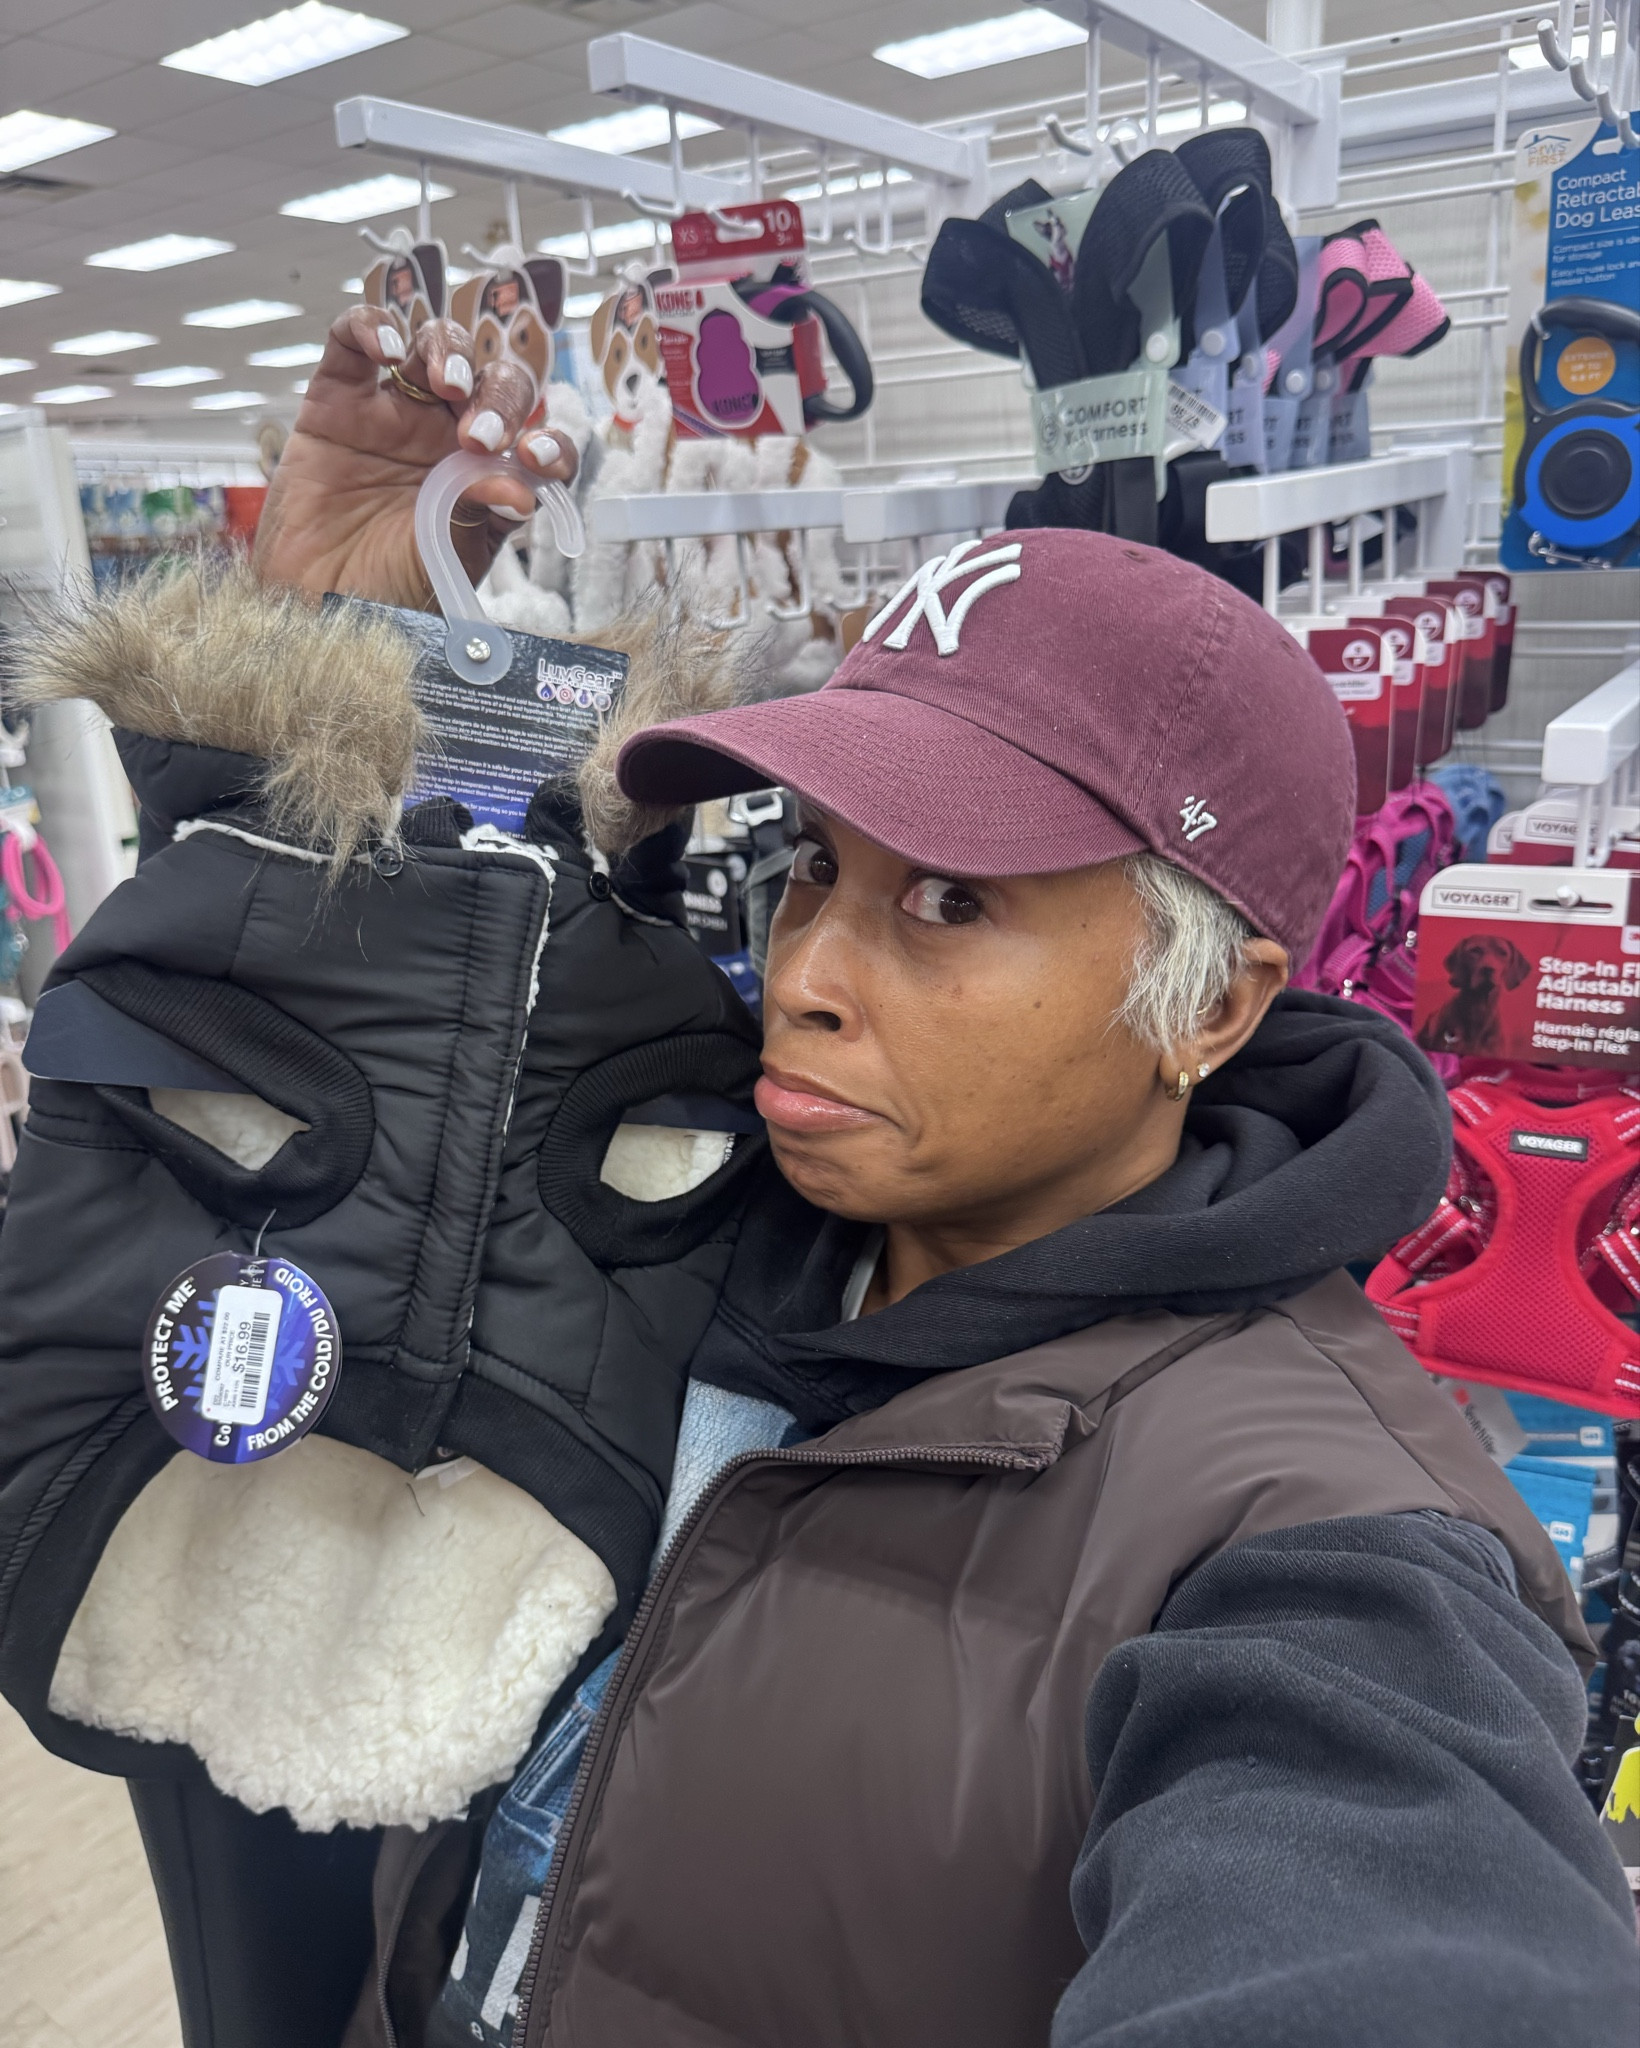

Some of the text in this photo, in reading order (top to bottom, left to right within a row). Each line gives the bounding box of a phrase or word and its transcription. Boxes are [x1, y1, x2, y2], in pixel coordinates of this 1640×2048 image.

[1528, 151, 1566, 166] FIRST
[1557, 168, 1627, 190] Compact
[763, 208, 793, 233] 10
[1555, 211, 1594, 228] Dog
[1552, 241, 1594, 254] Compact
[1596, 238, 1615, 248] size
[1552, 250, 1602, 263] for storage
[1606, 261, 1626, 271] lock
[1550, 273, 1616, 287] release button
[1060, 396, 1148, 427] COMFORT
[862, 540, 1023, 656] NY
[538, 658, 615, 690] LuvGear
[1439, 891, 1510, 906] VOYAGER
[1538, 956, 1619, 980] Step-In
[1536, 974, 1640, 998] Adjustabl
[1535, 991, 1626, 1015] Harness
[1533, 1019, 1598, 1039] Harnais
[1531, 1033, 1630, 1056] Step-In Flex
[1517, 1133, 1583, 1155] VOYAGER
[151, 1278, 198, 1412] PROTECT ME
[224, 1329, 236, 1367] OUR PRICE
[231, 1320, 253, 1373] $16.99
[214, 1347, 225, 1381] COMPARE
[220, 1336, 226, 1345] AT
[246, 1266, 335, 1452] FROM THE COLD/DU FROID
